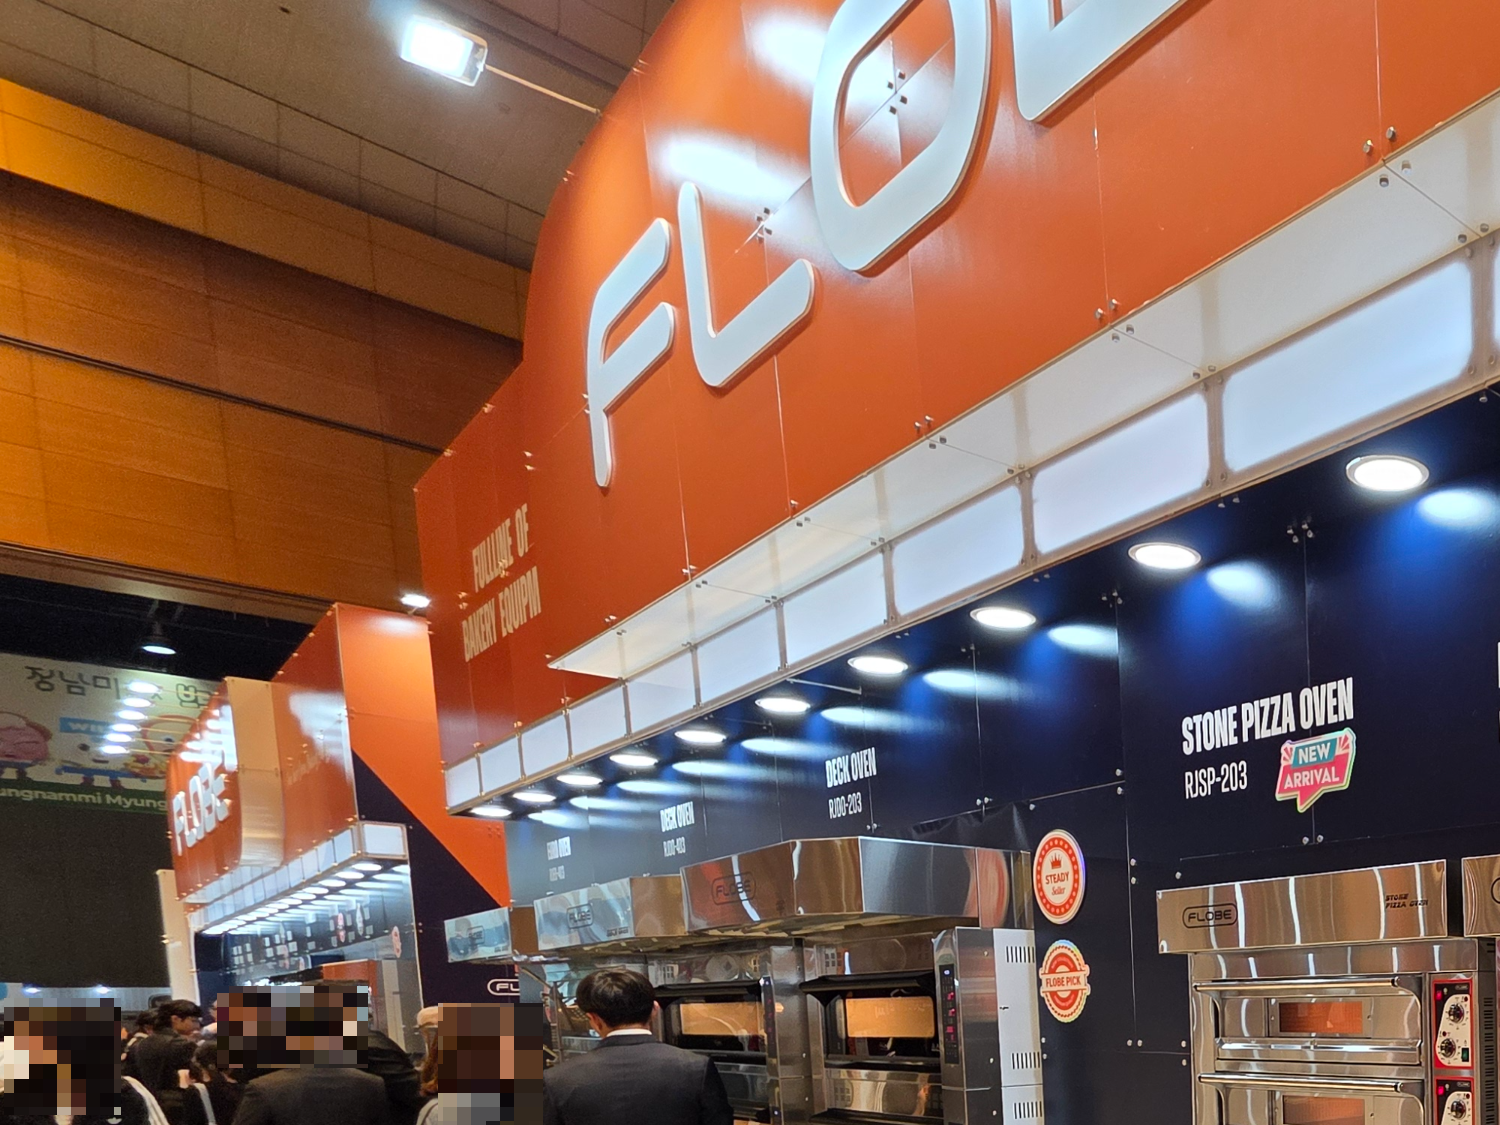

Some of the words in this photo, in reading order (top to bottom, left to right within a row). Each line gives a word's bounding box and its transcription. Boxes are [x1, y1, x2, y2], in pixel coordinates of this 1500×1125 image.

[515, 503, 529, 557] OF
[462, 597, 497, 662] BAKERY
[499, 566, 541, 638] EQUIPM
[1182, 706, 1238, 755] STONE
[1242, 692, 1295, 742] PIZZA
[1299, 677, 1354, 730] OVEN
[825, 754, 851, 788] DECK
[851, 747, 877, 780] OVEN
[1298, 743, 1331, 764] NEW
[1185, 760, 1247, 799] RJSP-203
[1284, 766, 1339, 789] ARRIVAL
[660, 806, 677, 832] DECK
[677, 801, 695, 827] OVEN
[1045, 871, 1069, 885] STEADY
[1188, 908, 1232, 923] FLOBE
[1046, 976, 1065, 988] FLOBE
[1066, 975, 1081, 987] PICK
